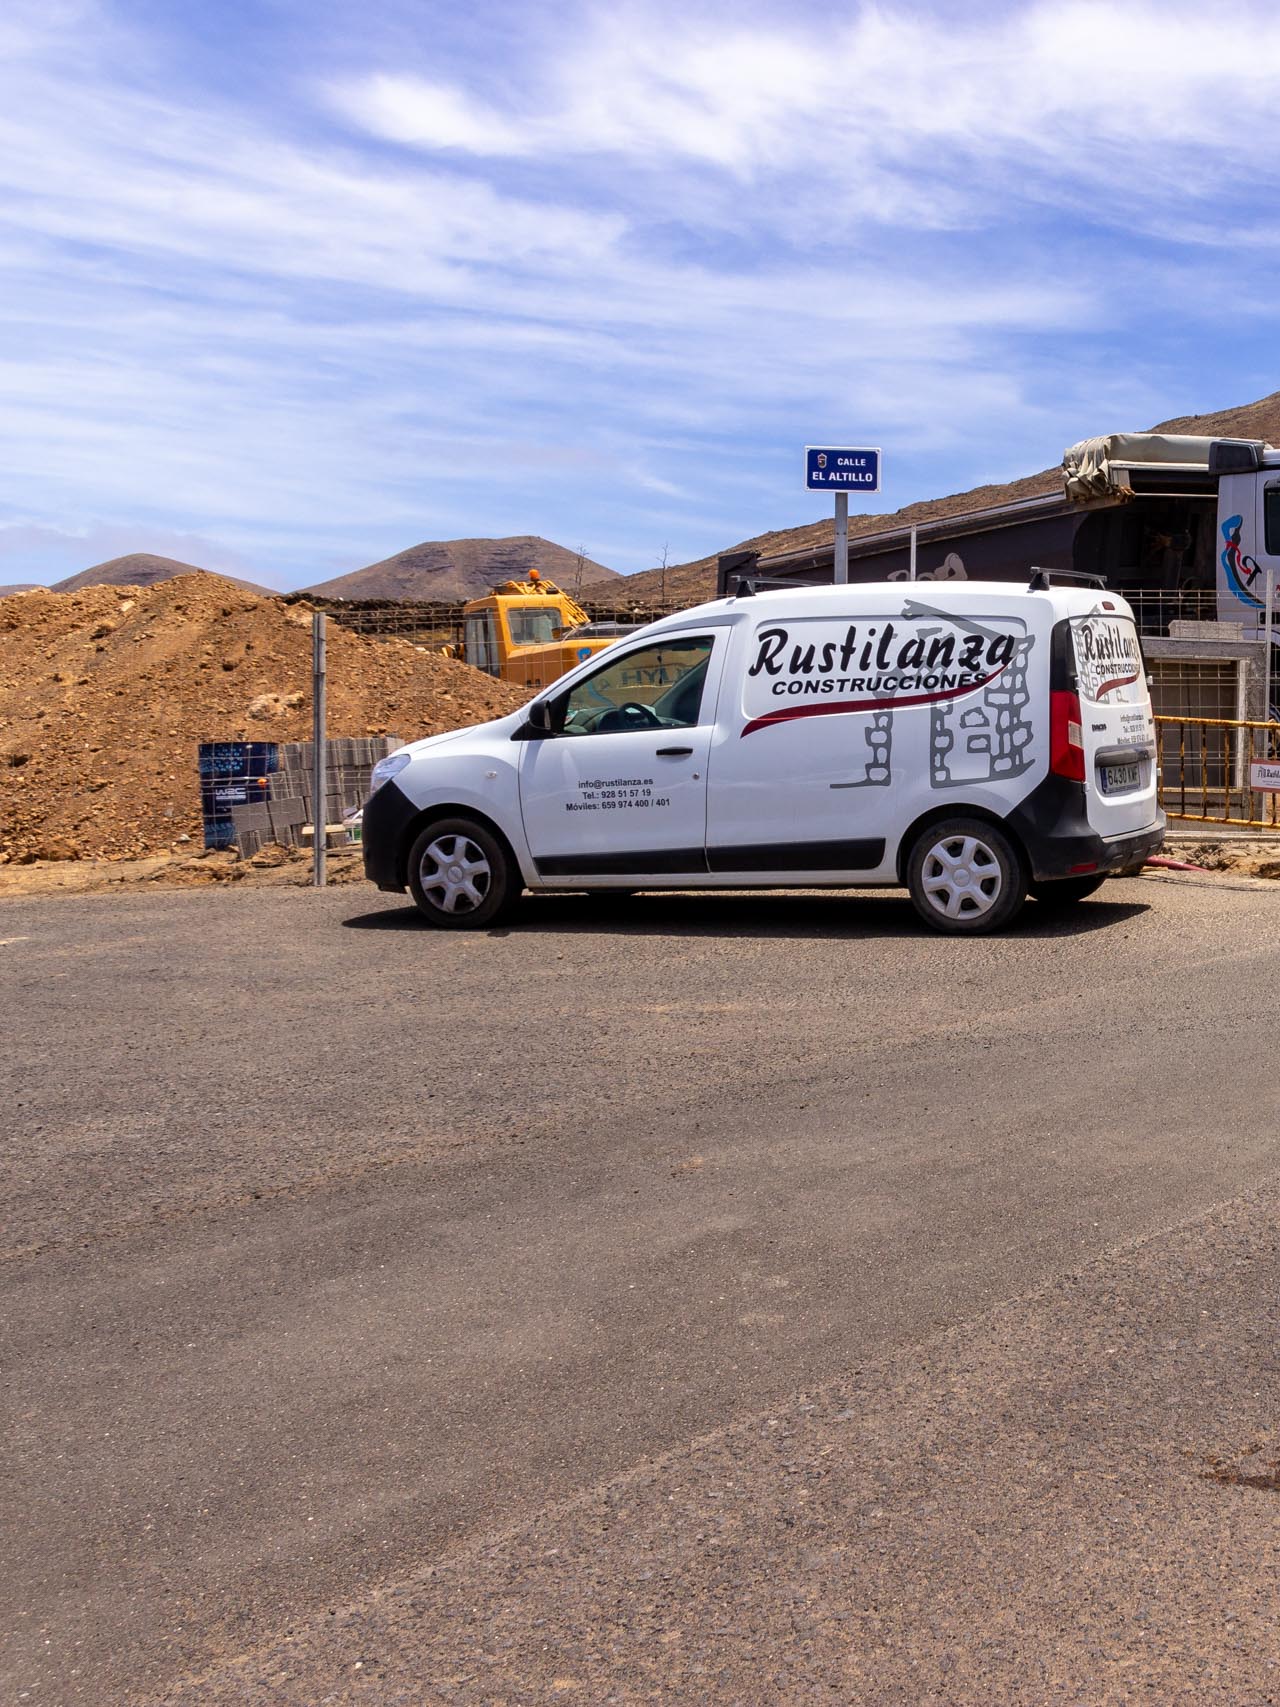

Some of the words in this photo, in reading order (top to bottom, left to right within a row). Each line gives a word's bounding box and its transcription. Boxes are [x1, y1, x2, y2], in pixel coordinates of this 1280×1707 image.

[837, 458, 867, 466] CALLE
[812, 472, 826, 481] EL
[829, 472, 873, 482] ALTILLO
[748, 623, 1015, 677] Rustilanza
[772, 672, 989, 695] CONSTRUCCIONES
[1108, 767, 1127, 786] 6430
[578, 779, 653, 790] info@rustilanza.es
[582, 791, 599, 800] Tel.:
[601, 791, 616, 799] 928
[618, 790, 627, 798] 51
[630, 789, 639, 797] 57
[642, 788, 652, 797] 19
[602, 801, 616, 810] 659
[618, 801, 632, 809] 974
[635, 799, 649, 808] 400
[656, 798, 670, 807] 401
